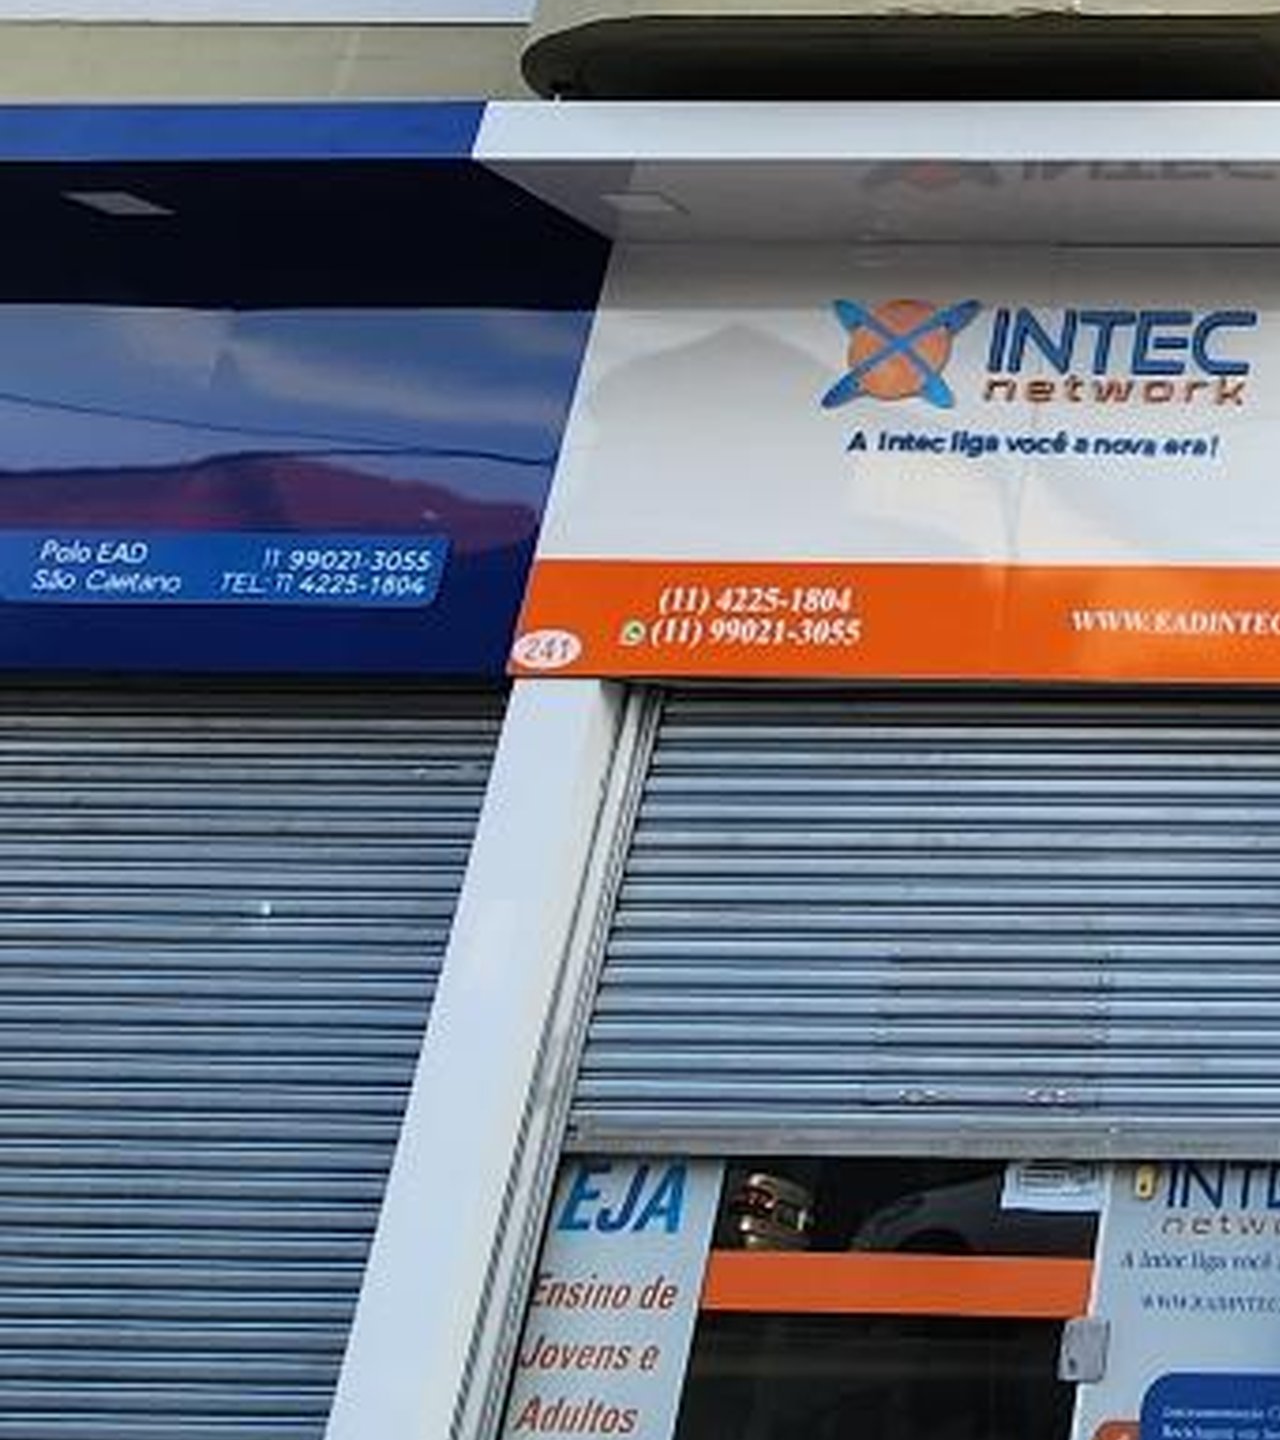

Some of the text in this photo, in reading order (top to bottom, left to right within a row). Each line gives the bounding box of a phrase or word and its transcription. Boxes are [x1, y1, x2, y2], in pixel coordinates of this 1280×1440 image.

[986, 307, 1258, 376] INTEC
[983, 374, 1247, 406] network
[846, 432, 868, 453] A
[878, 432, 946, 455] Intec
[950, 431, 998, 457] liga
[1006, 431, 1068, 455] você
[1073, 438, 1087, 455] a
[1094, 438, 1156, 458] nova
[40, 538, 149, 565] Polo EAD
[288, 550, 432, 571] 99021-3055
[32, 567, 181, 593] São Caetano
[659, 586, 853, 614] (11) 4225-1804
[650, 618, 862, 647] (11) 99021-3055
[522, 636, 571, 662] 241
[556, 1158, 689, 1234] EJA
[530, 1272, 678, 1310] Ensino de
[520, 1334, 661, 1371] Jovens e
[514, 1394, 640, 1434] Adultos
